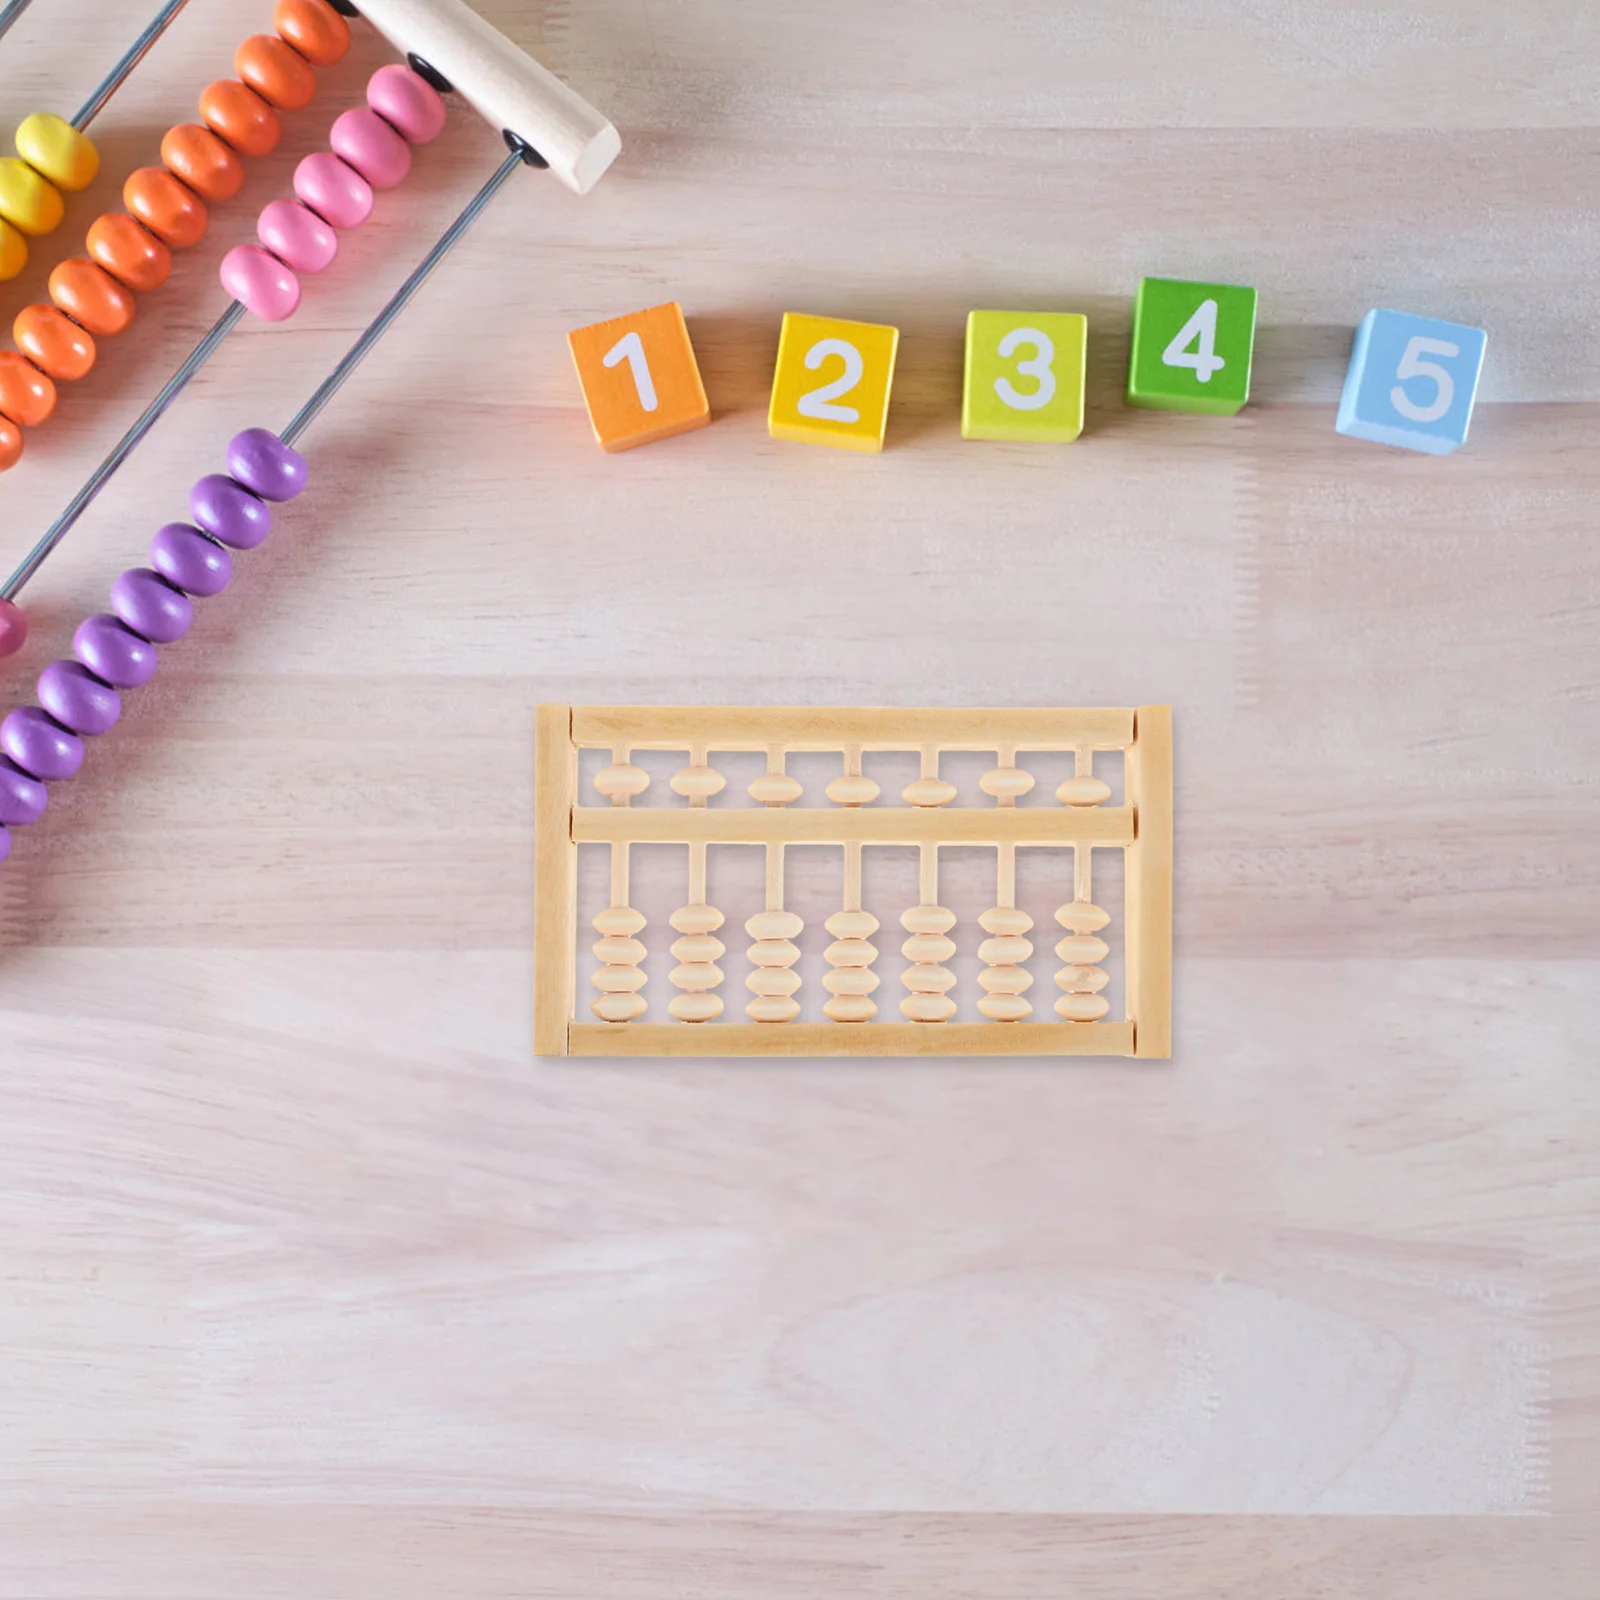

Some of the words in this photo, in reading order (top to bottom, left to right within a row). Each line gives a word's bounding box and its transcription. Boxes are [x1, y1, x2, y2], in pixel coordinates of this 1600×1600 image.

[602, 332, 658, 412] 1
[797, 338, 863, 423] 2
[993, 327, 1056, 411] 3
[1162, 299, 1225, 383] 4
[1390, 336, 1460, 422] 5
